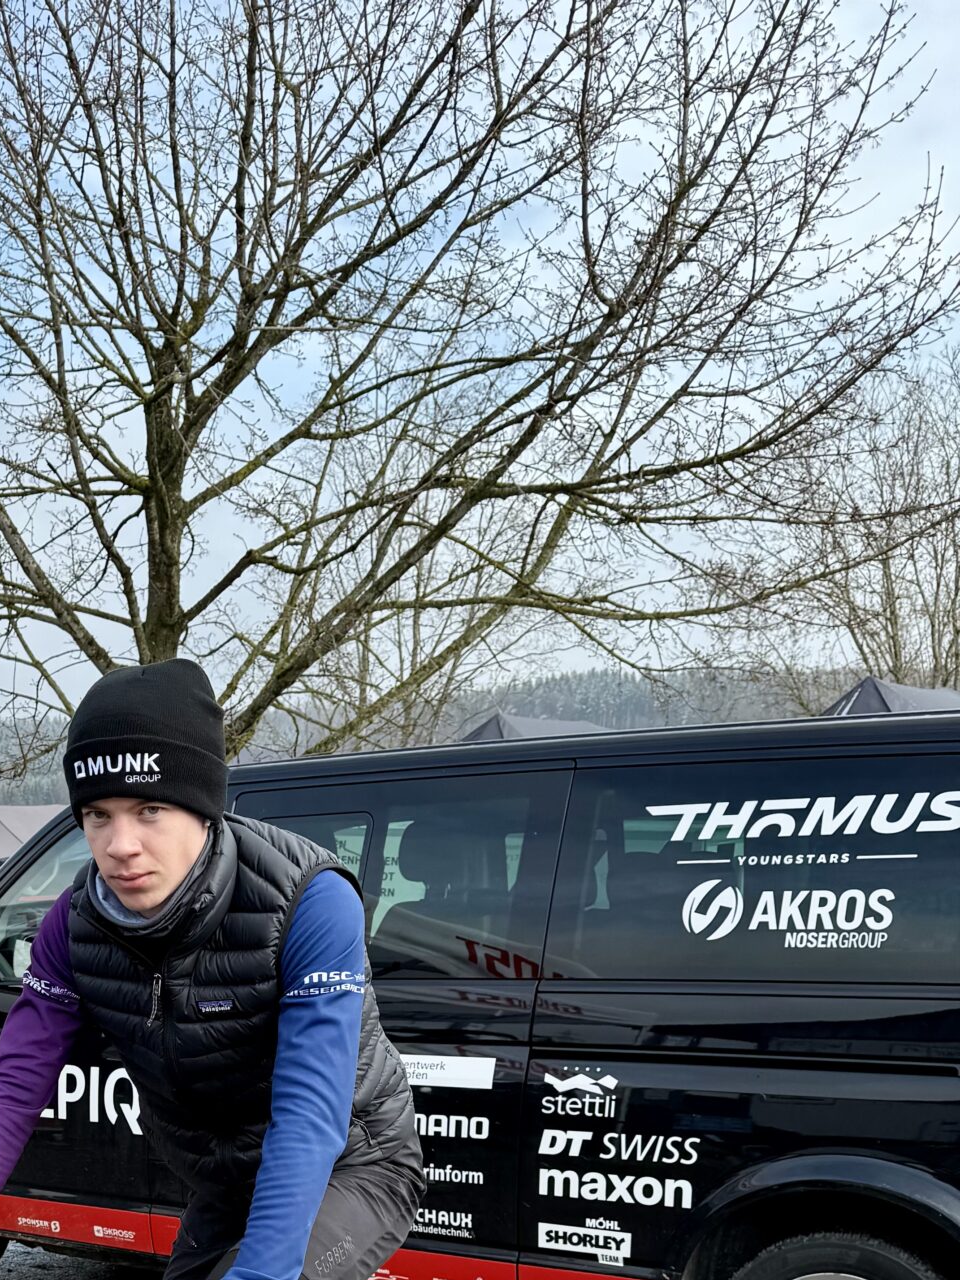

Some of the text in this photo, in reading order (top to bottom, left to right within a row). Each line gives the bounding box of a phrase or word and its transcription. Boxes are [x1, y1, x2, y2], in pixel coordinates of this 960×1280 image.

[125, 774, 161, 783] GROUP
[737, 853, 850, 866] YOUNGSTARS
[748, 888, 895, 931] AKROS
[784, 931, 888, 949] NOSERGROUP
[40, 1064, 143, 1136] PIQ
[541, 1094, 616, 1118] stettli
[538, 1129, 701, 1165] DT SWISS
[538, 1168, 693, 1209] maxon
[545, 1229, 626, 1251] SHORLEY
[601, 1254, 620, 1263] TEAM
